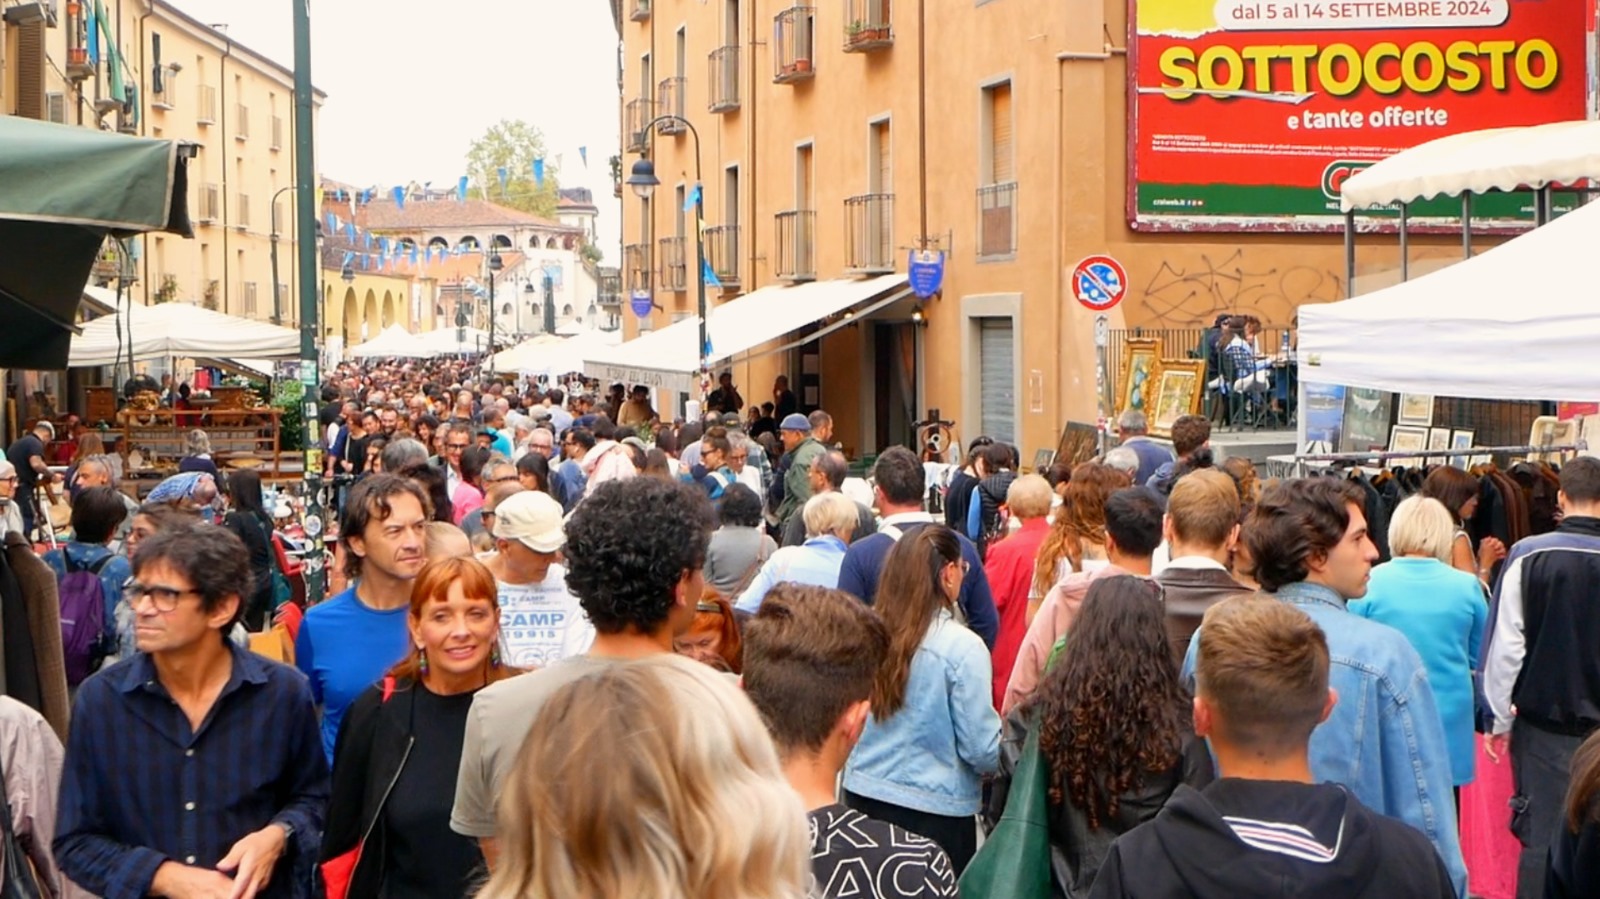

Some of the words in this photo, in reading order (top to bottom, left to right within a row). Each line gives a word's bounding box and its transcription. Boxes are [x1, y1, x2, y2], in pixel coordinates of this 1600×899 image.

[1232, 3, 1260, 19] dal
[1266, 4, 1277, 19] 5
[1283, 3, 1299, 18] al
[1304, 3, 1324, 18] 14
[1329, 2, 1445, 18] SETTEMBRE
[1447, 1, 1491, 16] 2024
[1159, 38, 1559, 99] SOTTOCOSTO
[1287, 115, 1299, 129] e
[1303, 109, 1364, 129] tante
[1369, 105, 1448, 128] offerte
[501, 614, 564, 626] CAMP
